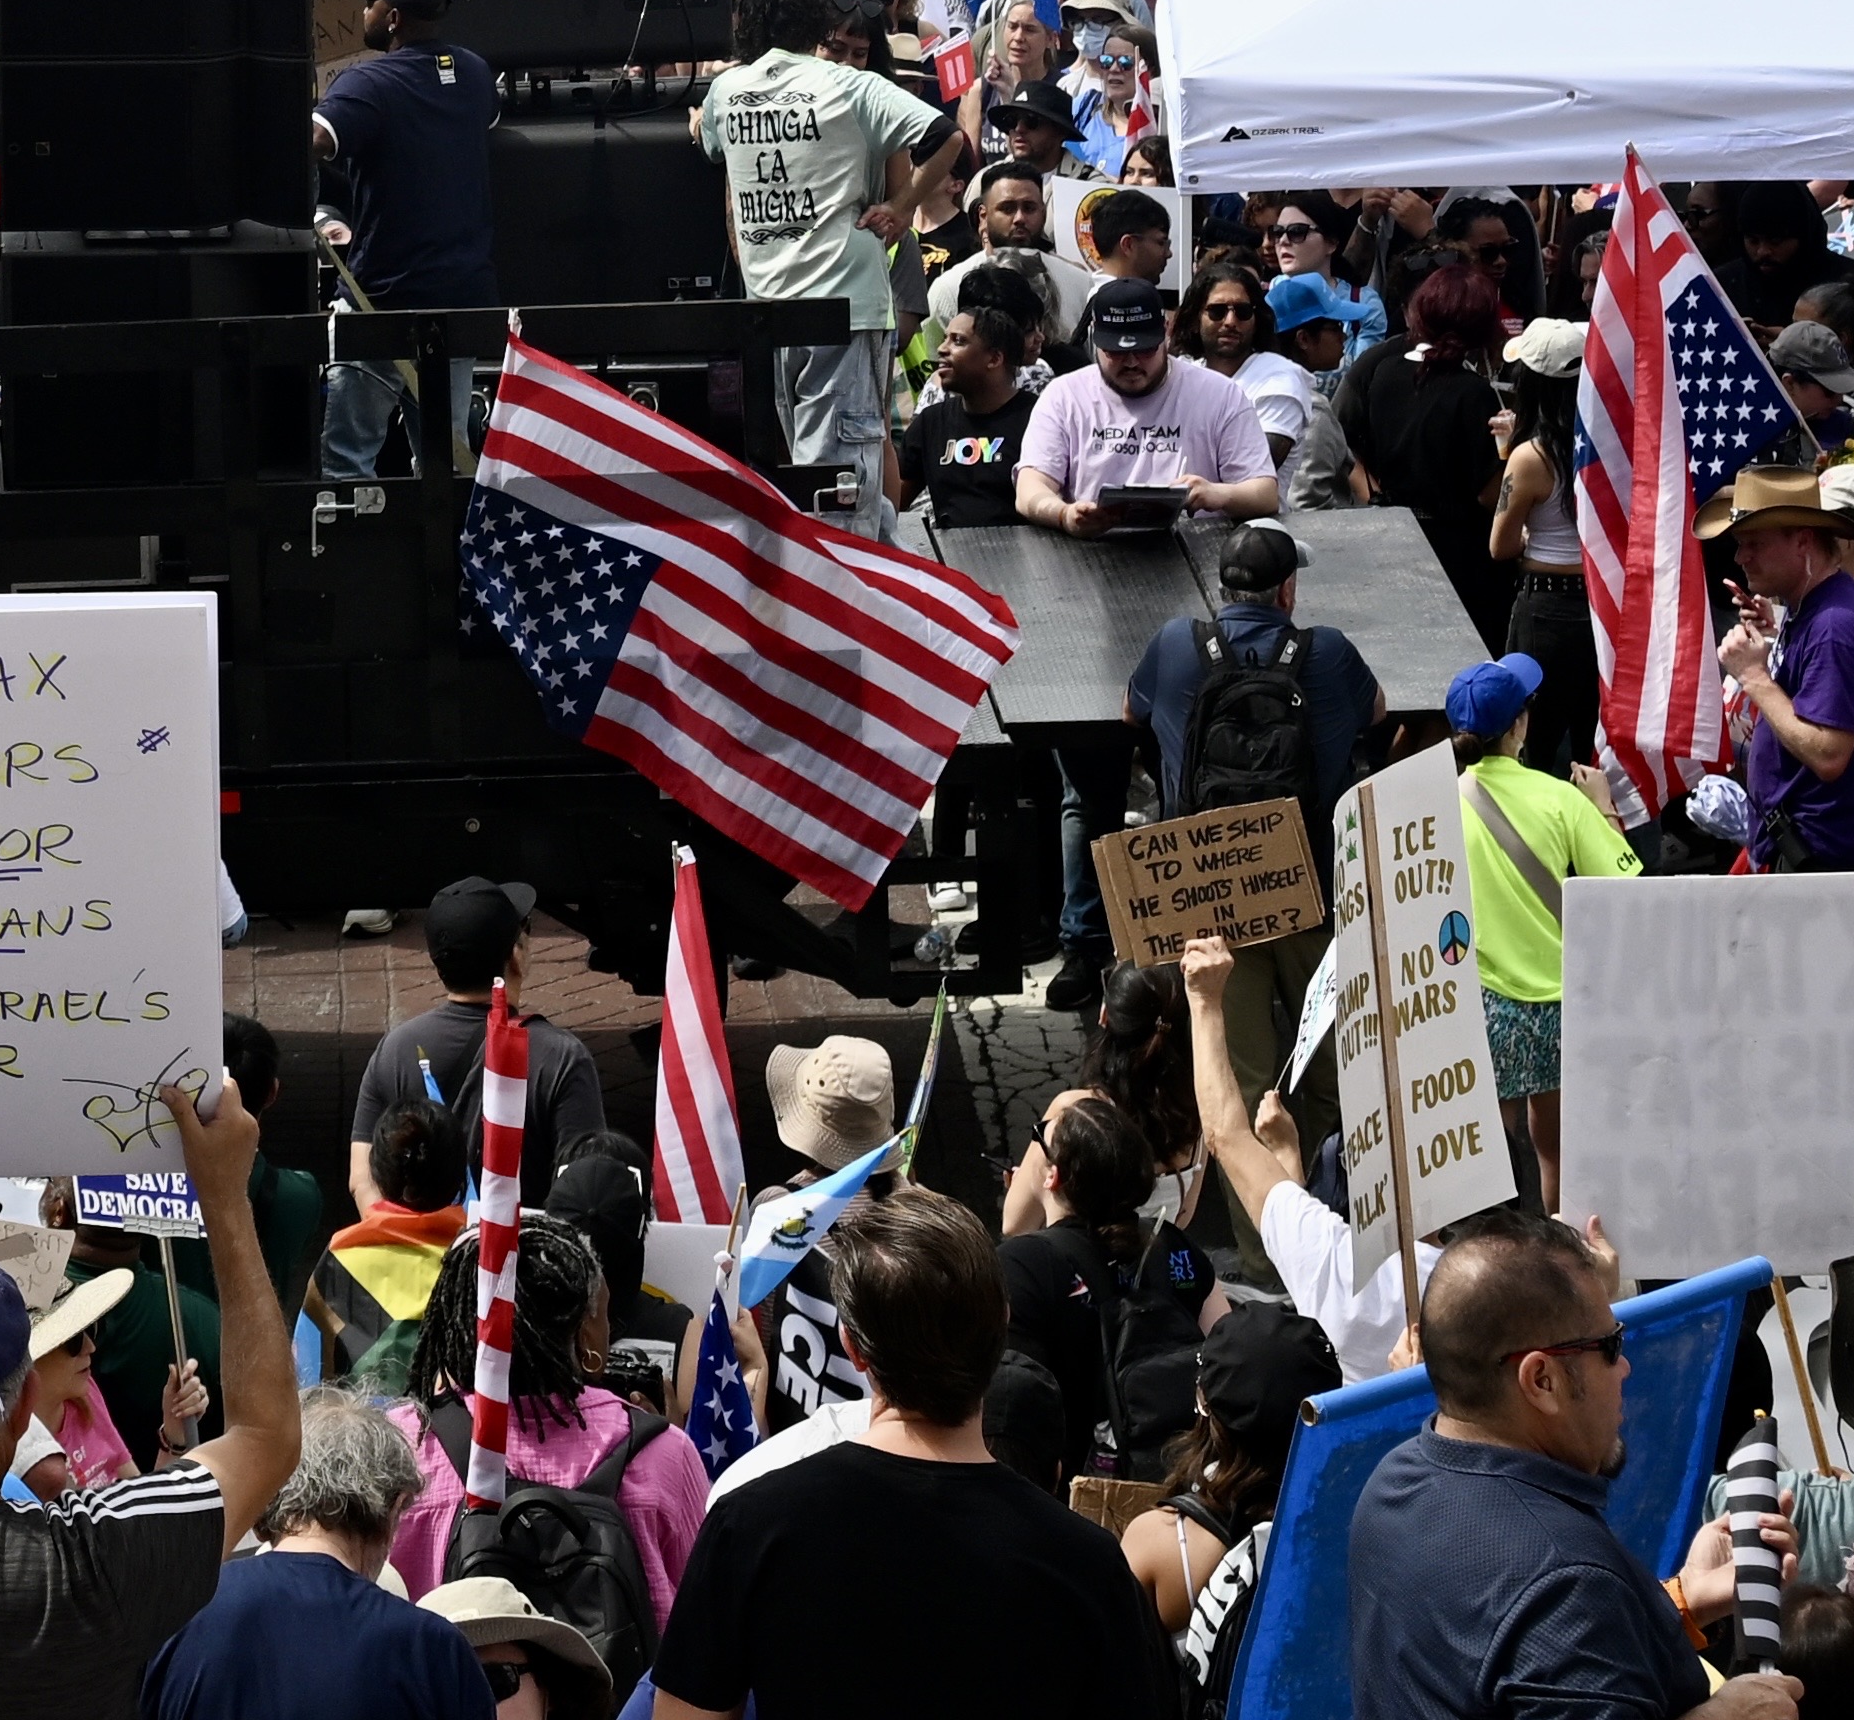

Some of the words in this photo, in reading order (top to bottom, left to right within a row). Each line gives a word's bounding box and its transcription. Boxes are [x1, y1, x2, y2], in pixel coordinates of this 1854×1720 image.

[725, 107, 823, 147] CHINGA
[756, 149, 792, 185] LA
[739, 187, 820, 225] MIGRA
[1127, 828, 1182, 861] CAN
[1230, 811, 1284, 841] SKIP
[1392, 815, 1437, 861] ICE
[1146, 858, 1182, 883] TO
[1189, 843, 1264, 874] WHERE
[1393, 859, 1455, 903] OUT!!
[1128, 891, 1164, 921] HE
[1172, 875, 1235, 911] SHOOTS
[1240, 864, 1306, 898] HIMSELF
[1214, 903, 1235, 922] IN
[1142, 930, 1186, 958] THE
[1400, 945, 1436, 988] NO
[1393, 979, 1458, 1037] WARS
[1410, 1058, 1476, 1114] FOOD
[1416, 1121, 1484, 1178] LOVE
